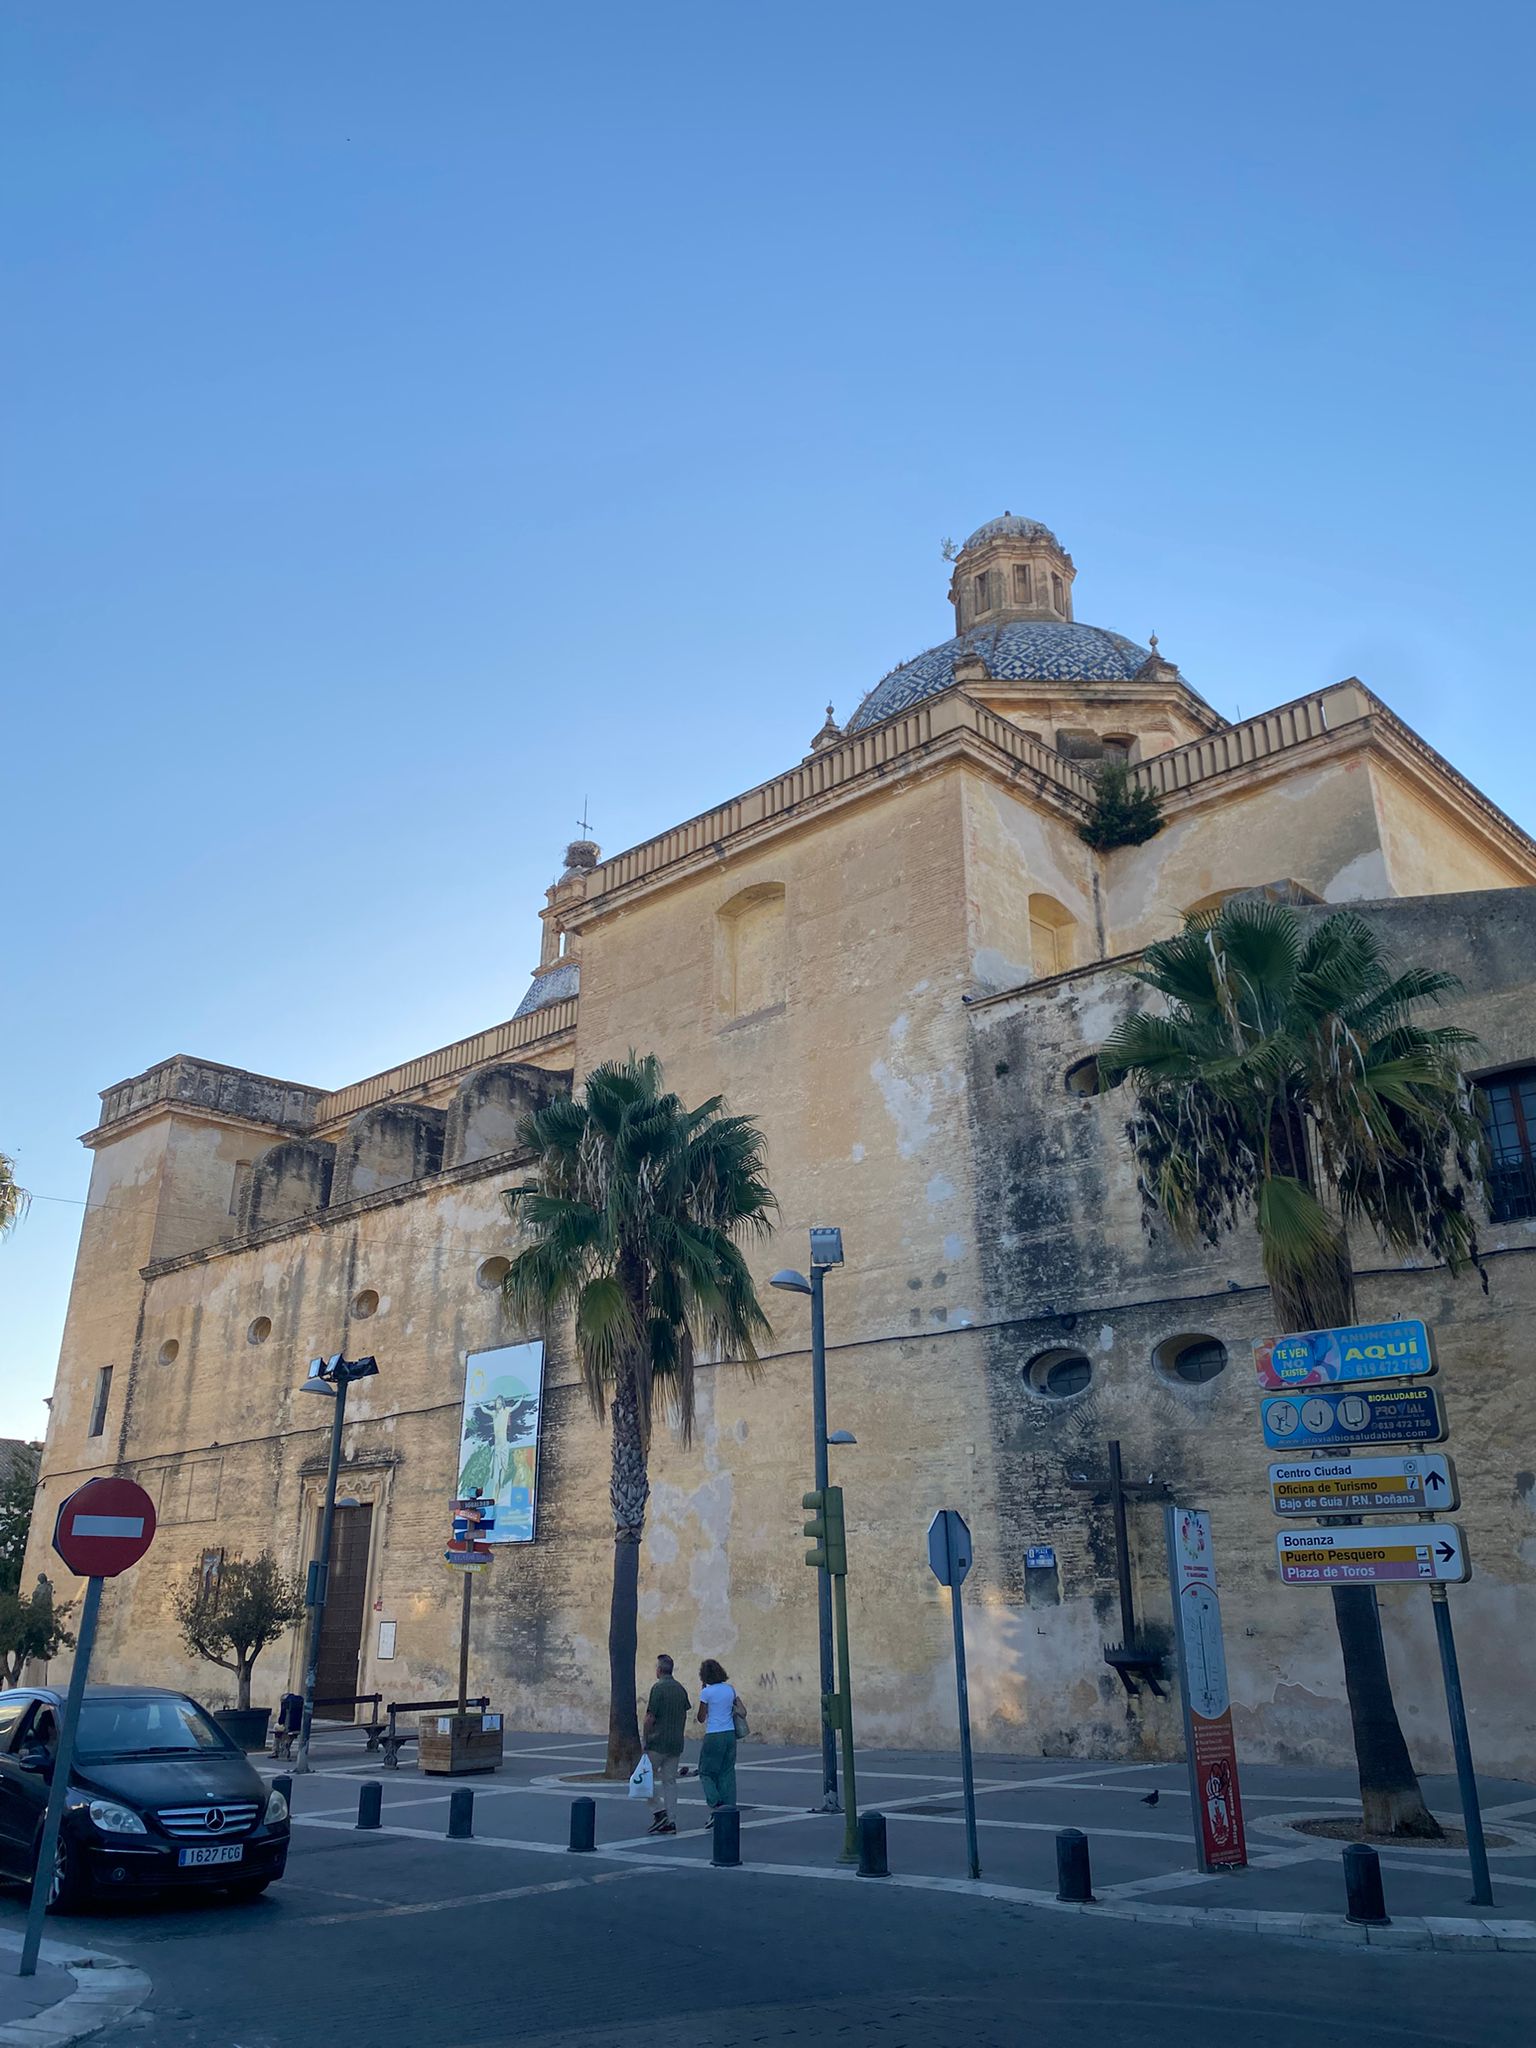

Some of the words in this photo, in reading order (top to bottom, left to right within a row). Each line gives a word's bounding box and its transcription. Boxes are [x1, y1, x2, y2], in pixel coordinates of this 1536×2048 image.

[1276, 1349, 1290, 1359] TE
[1290, 1347, 1308, 1358] VEN
[1345, 1337, 1418, 1361] AQUÍ
[1283, 1359, 1304, 1368] NO
[1380, 1360, 1400, 1374] 472
[1281, 1367, 1308, 1378] EXISTES
[1368, 1390, 1428, 1402] BIOSALUDABLES
[1396, 1420, 1412, 1428] 472
[1276, 1467, 1311, 1479] Centro
[1314, 1465, 1352, 1477] Ciudad
[1278, 1483, 1315, 1495] Oficina
[1318, 1482, 1331, 1493] de
[1334, 1480, 1378, 1492] Turismo
[1280, 1499, 1301, 1511] Bajo
[1304, 1497, 1317, 1508] de
[1352, 1495, 1372, 1506] P.N.
[1375, 1493, 1416, 1504] Doñana
[1284, 1535, 1334, 1547] Bonanza
[1286, 1550, 1324, 1562] Puerto
[1328, 1549, 1386, 1563] Pesquero
[1288, 1567, 1320, 1578] Plaza
[1323, 1566, 1338, 1577] de
[1341, 1564, 1375, 1577] Toros
[191, 1849, 219, 1863] 1627
[221, 1847, 241, 1860] FCG
